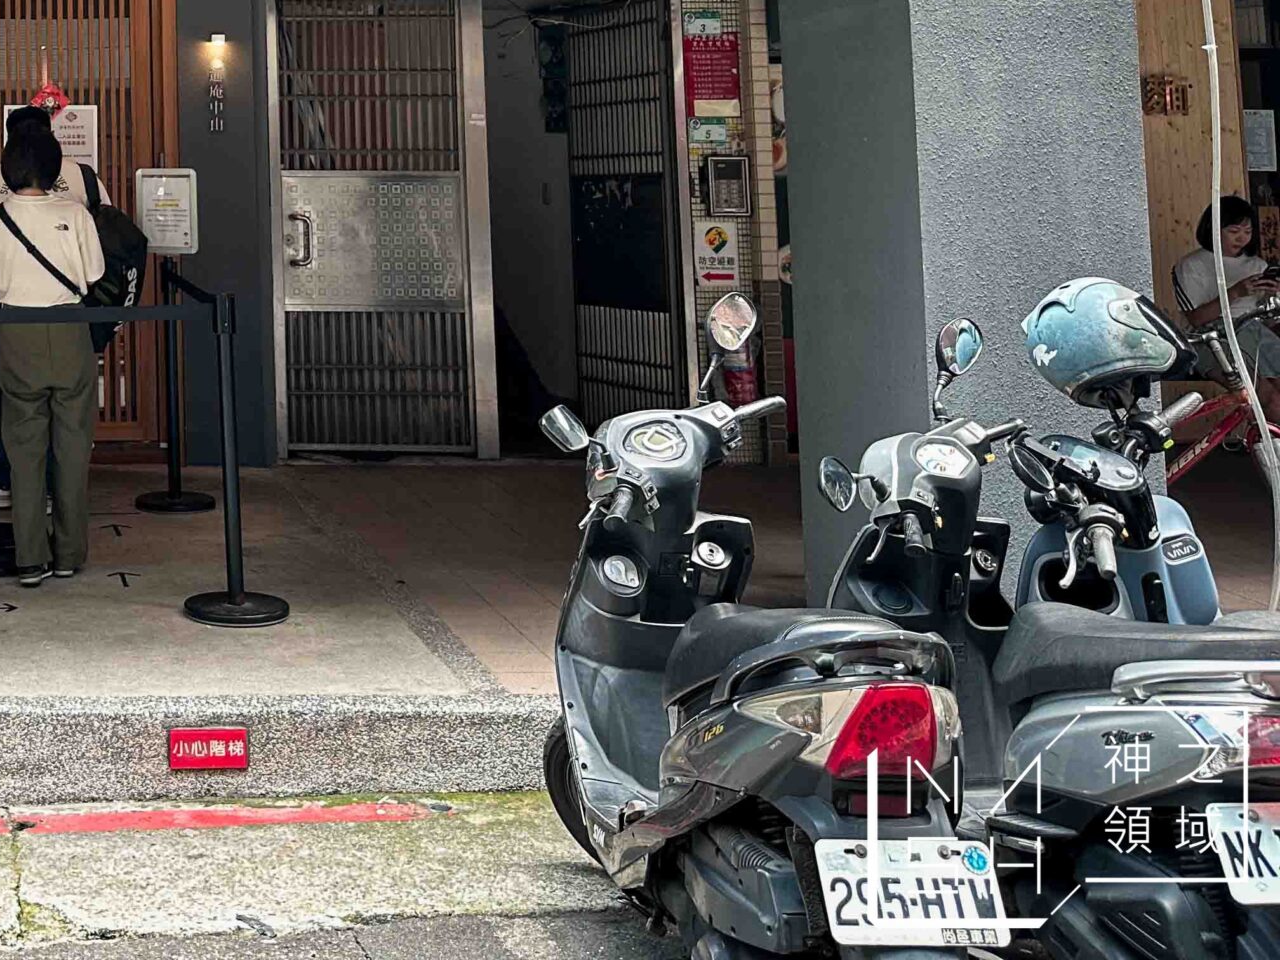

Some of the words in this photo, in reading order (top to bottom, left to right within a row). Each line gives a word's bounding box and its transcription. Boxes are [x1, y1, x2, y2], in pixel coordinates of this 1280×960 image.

[700, 23, 706, 33] 3
[705, 129, 711, 139] 5
[1167, 544, 1196, 559] VIVA
[172, 739, 245, 758] 小心階梯
[1221, 828, 1280, 878] NK
